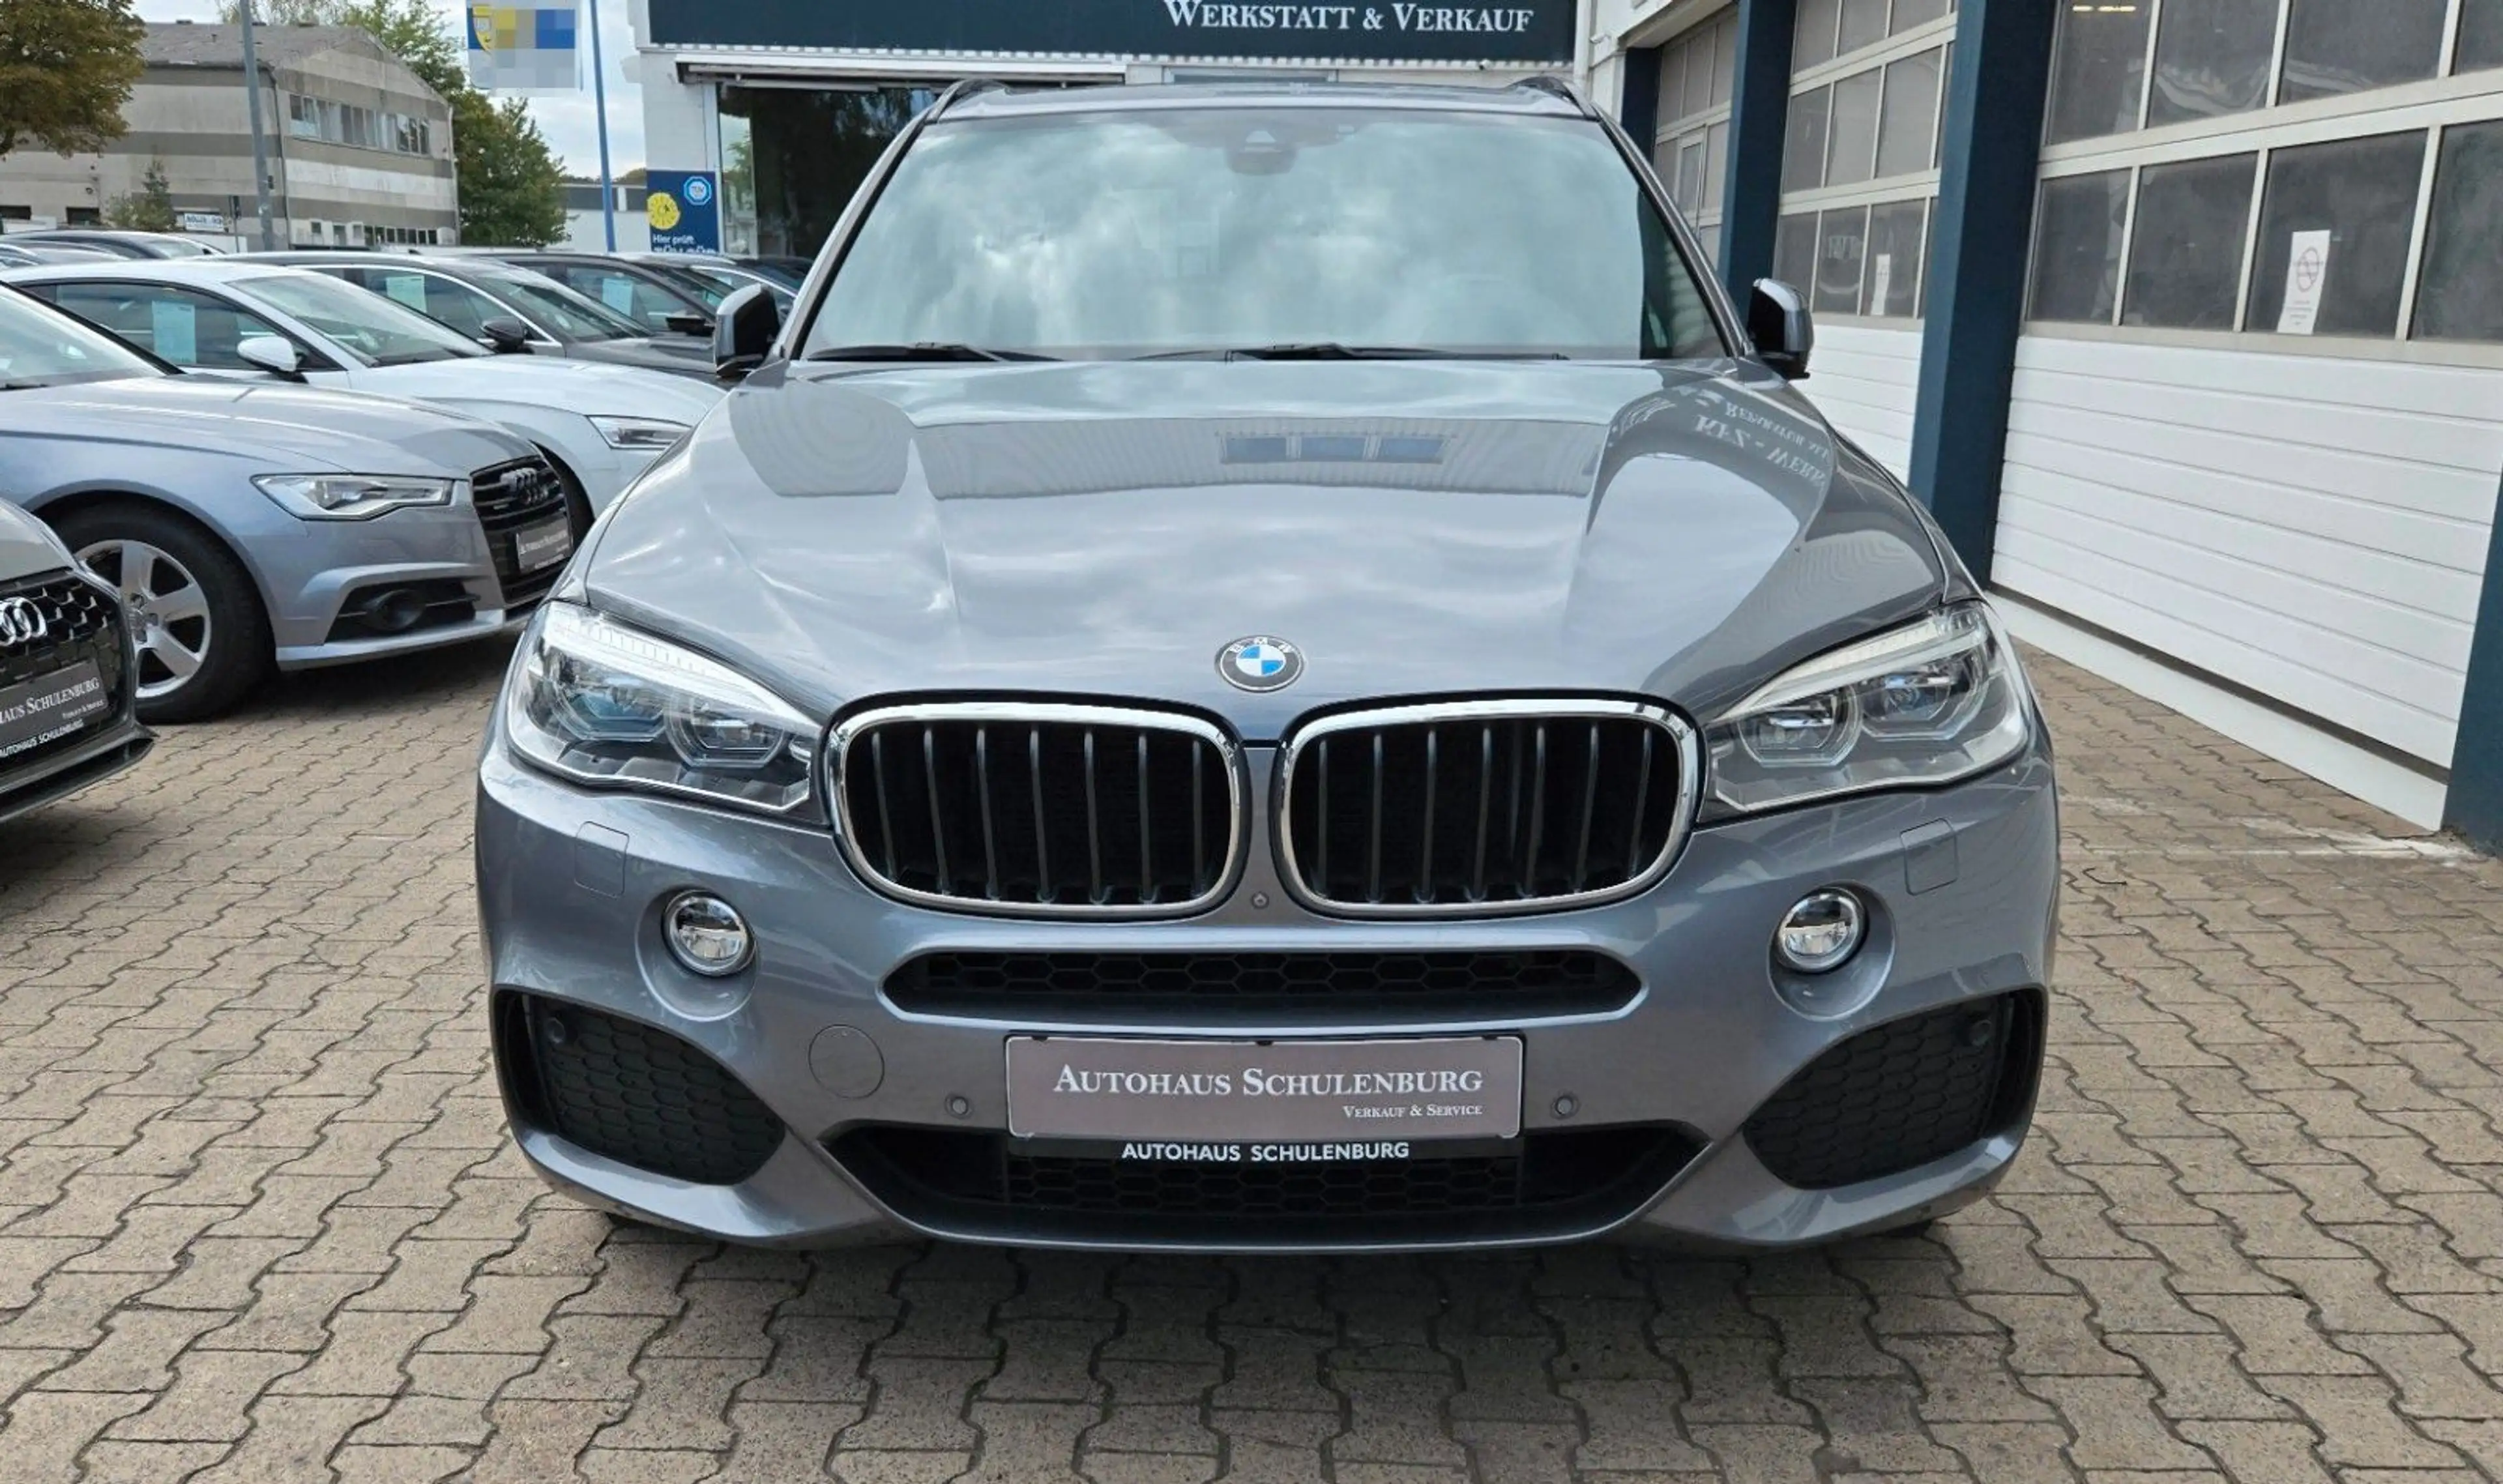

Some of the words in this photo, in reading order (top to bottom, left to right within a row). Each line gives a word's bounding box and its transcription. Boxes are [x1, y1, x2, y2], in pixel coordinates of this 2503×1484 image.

[1164, 0, 1355, 29] WERKSTATT
[1362, 8, 1383, 30] &
[1392, 3, 1534, 32] VERKAUF
[1053, 1064, 1232, 1096] AUTOHAUS
[1243, 1068, 1484, 1096] SCHULENBURG
[1343, 1105, 1406, 1118] VERKAUF
[1409, 1105, 1422, 1117] &
[1426, 1103, 1483, 1116] SERVICE
[1122, 1143, 1241, 1162] AUTOHAUS
[1250, 1142, 1409, 1161] SCHULENBURG
